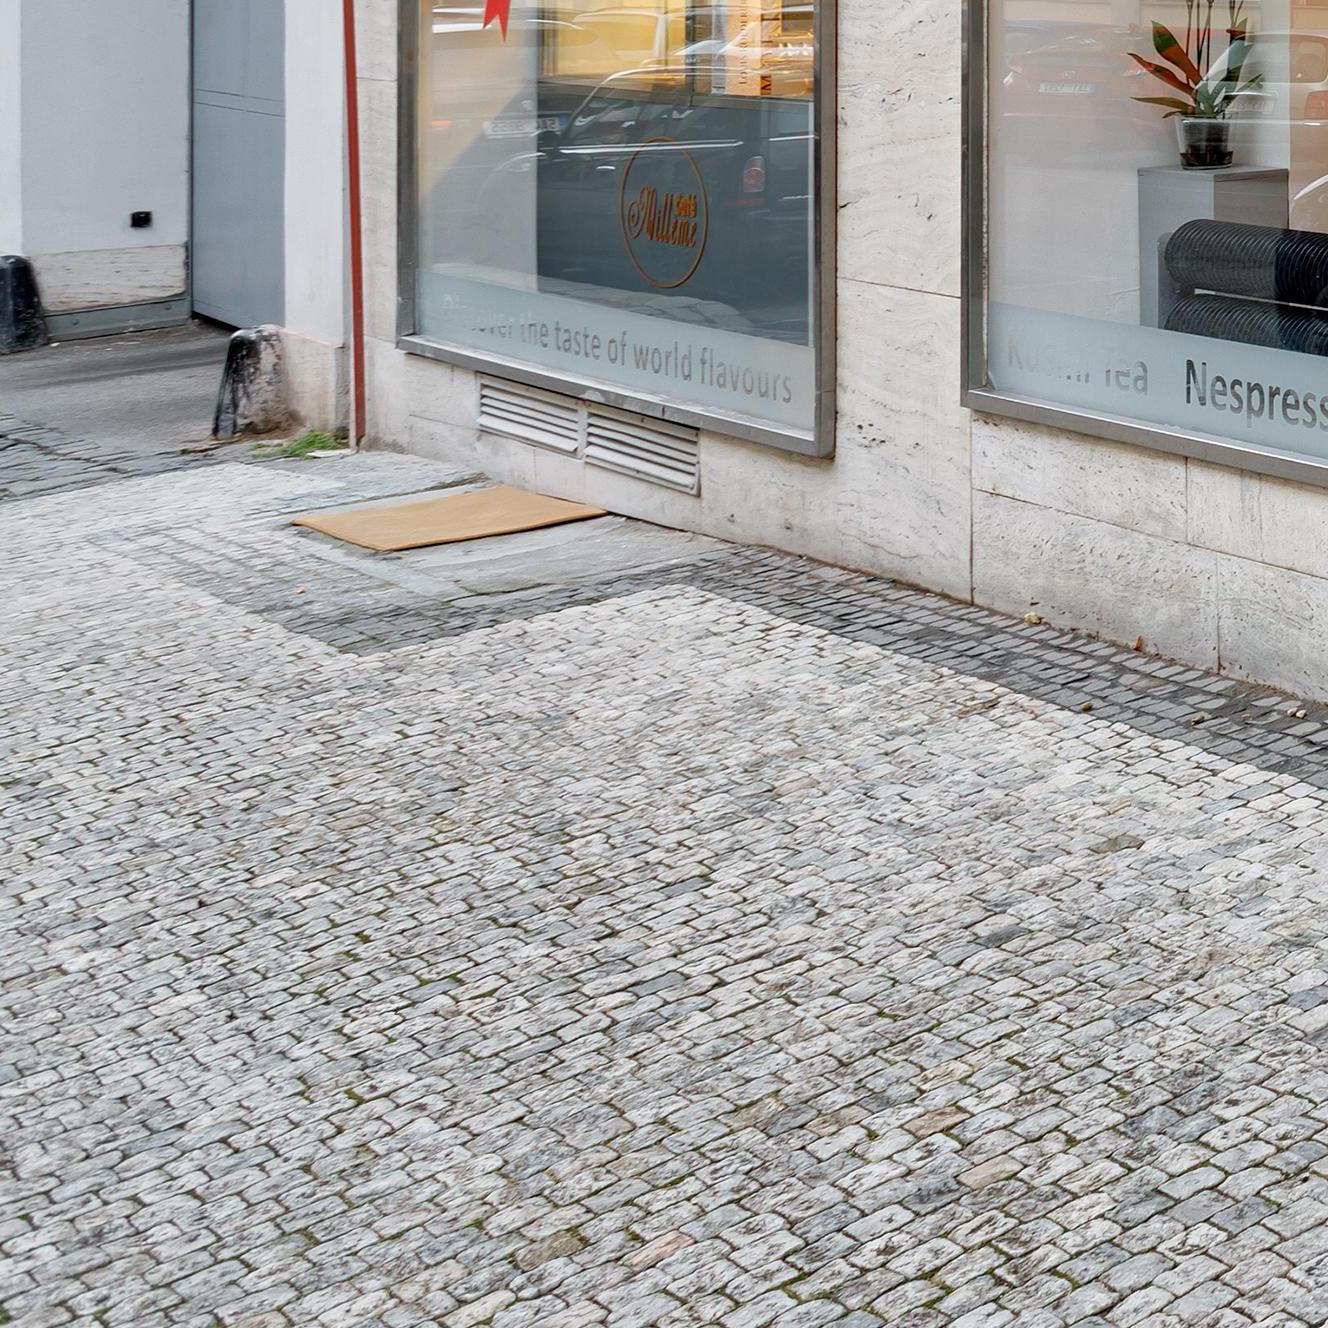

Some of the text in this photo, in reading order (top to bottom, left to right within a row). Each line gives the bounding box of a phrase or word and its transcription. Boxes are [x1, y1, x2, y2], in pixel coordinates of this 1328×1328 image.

[554, 321, 601, 361] taste
[607, 330, 627, 367] of
[633, 340, 692, 382] world
[699, 345, 793, 405] flavours
